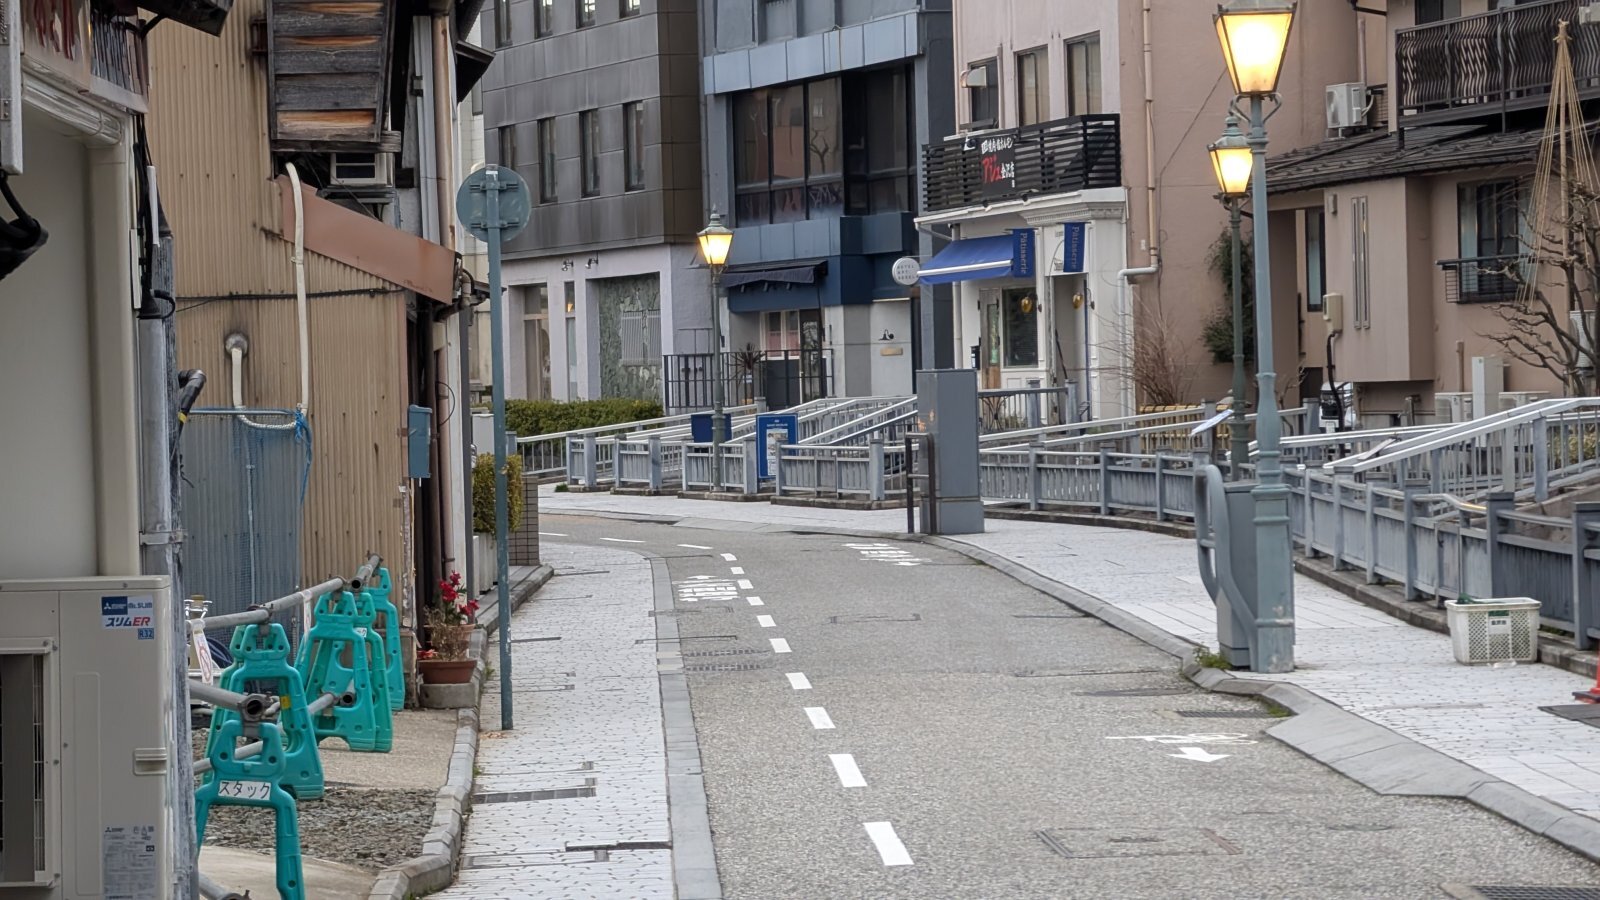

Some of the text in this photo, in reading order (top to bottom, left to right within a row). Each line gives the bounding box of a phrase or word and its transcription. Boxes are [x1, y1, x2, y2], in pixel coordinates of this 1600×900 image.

[105, 616, 151, 627] スリムER
[219, 781, 270, 799] スタック
